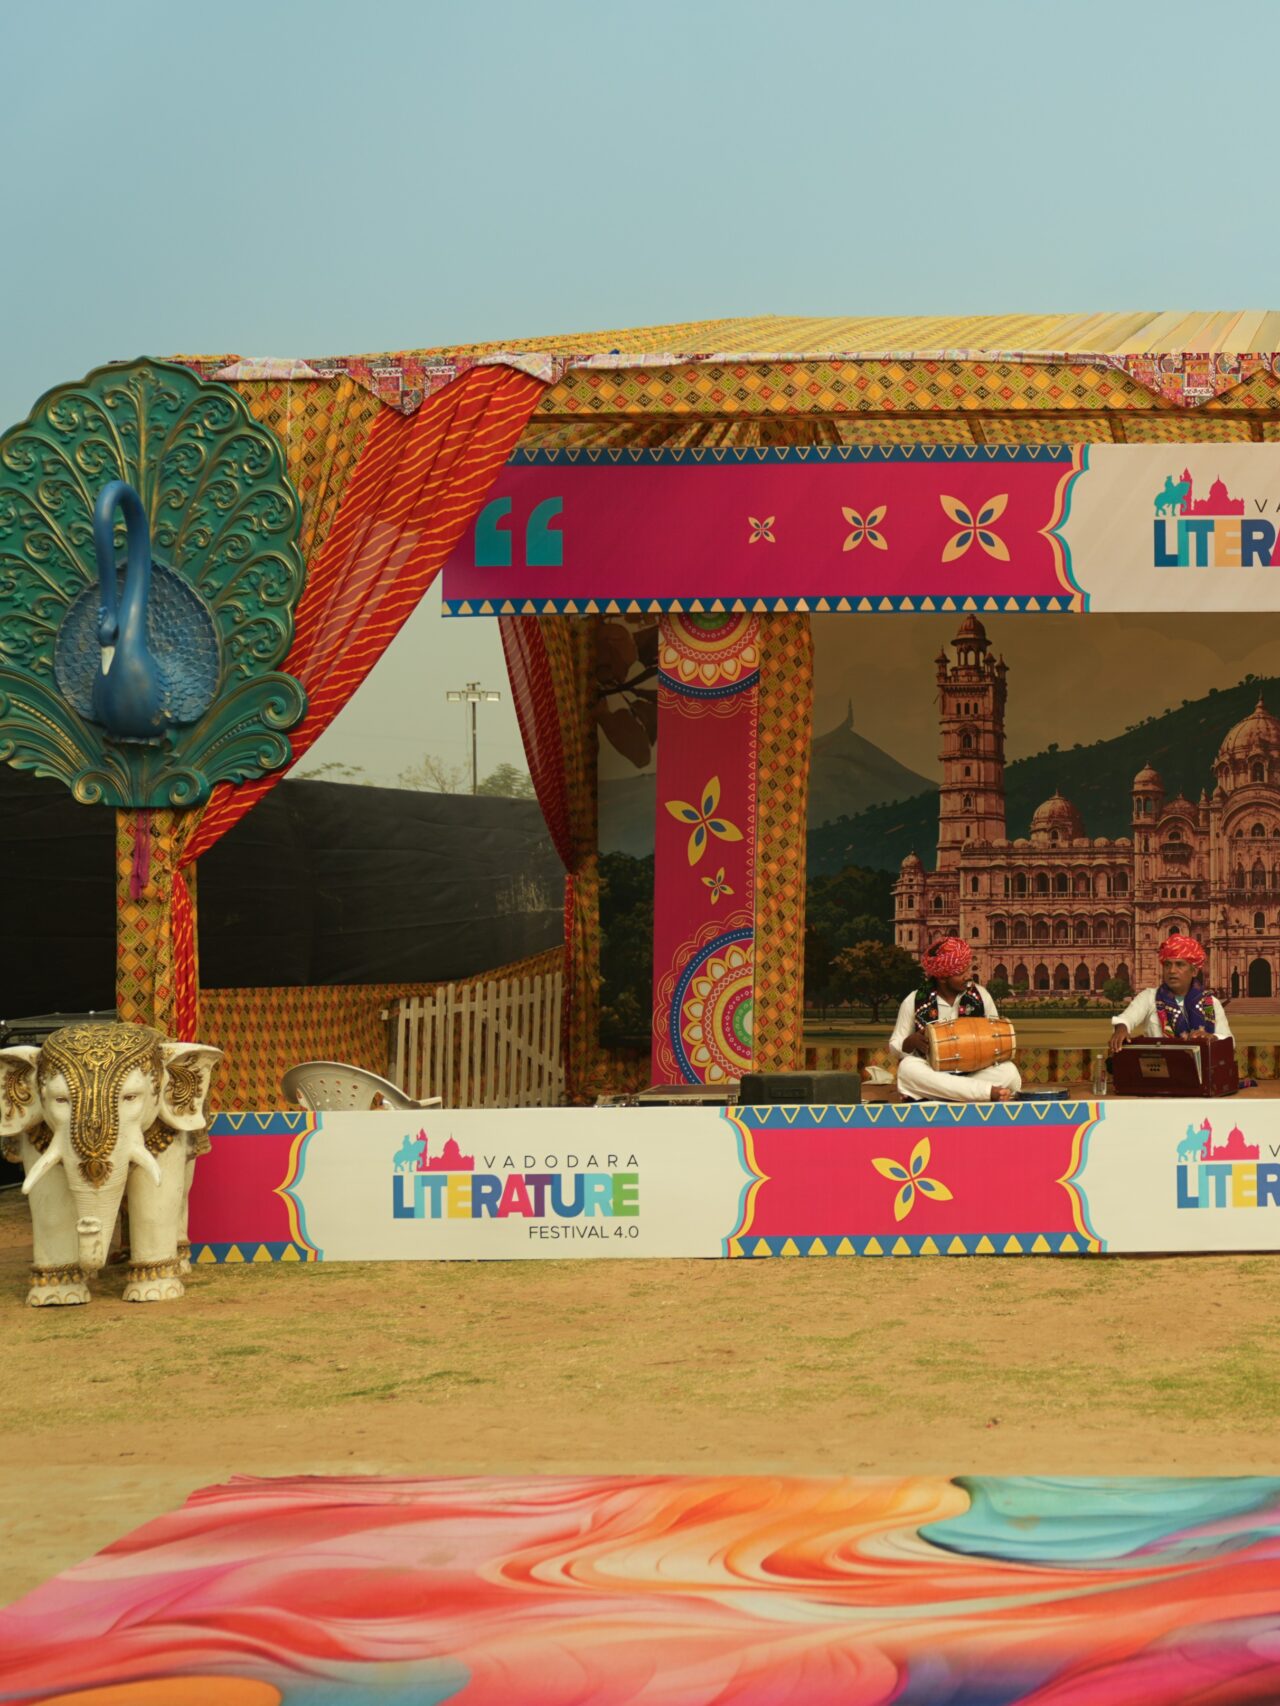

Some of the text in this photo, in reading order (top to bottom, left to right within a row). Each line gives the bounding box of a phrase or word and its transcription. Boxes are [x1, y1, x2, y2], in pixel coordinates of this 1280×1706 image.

[483, 1154, 639, 1169] VADODARA
[392, 1173, 640, 1219] LITERATURE
[528, 1225, 639, 1239] FESTIVAL 4.0
